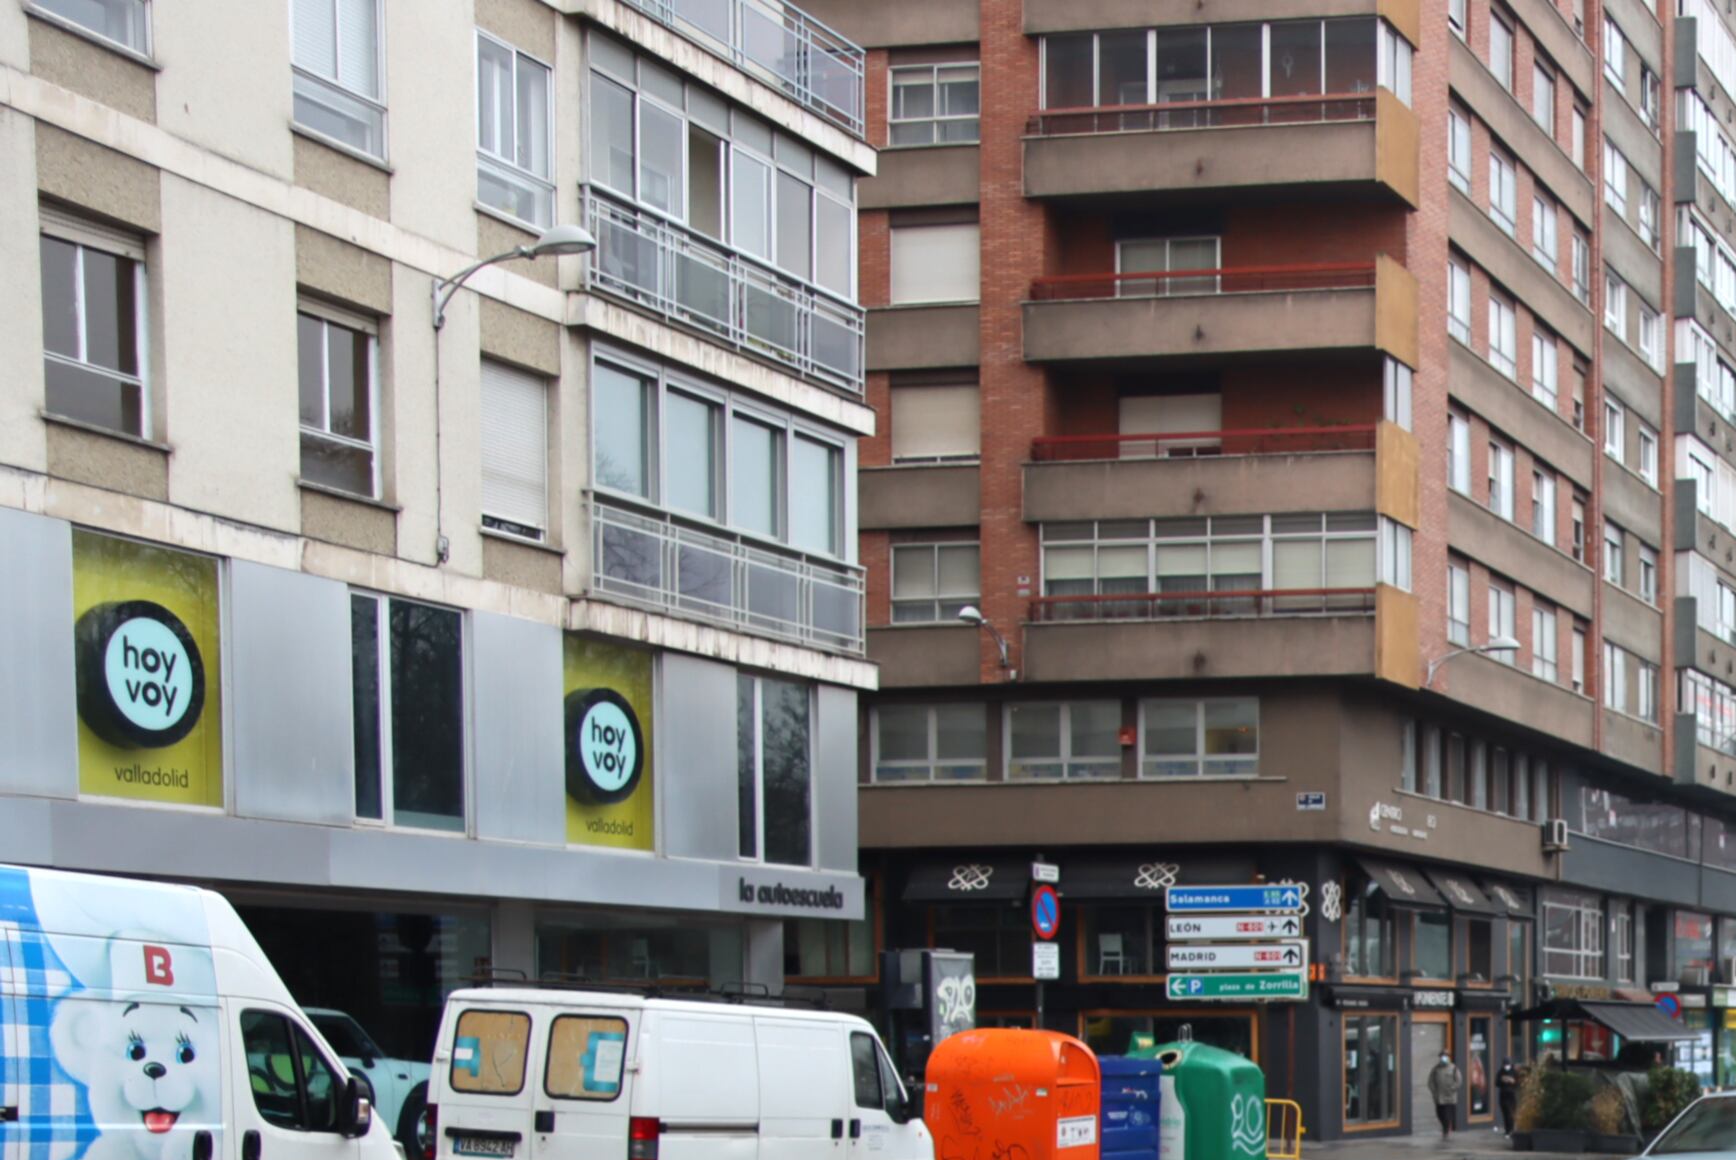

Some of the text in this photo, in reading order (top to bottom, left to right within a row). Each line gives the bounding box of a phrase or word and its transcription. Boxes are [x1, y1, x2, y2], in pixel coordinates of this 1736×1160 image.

[123, 635, 176, 683] hoy
[125, 679, 177, 717] voy
[591, 716, 626, 753] hoy
[114, 764, 189, 788] valladolid
[592, 751, 626, 780] voy
[586, 817, 634, 836] valladolid
[739, 877, 843, 909] la autoescuela
[1169, 893, 1231, 905] Salamanca
[1169, 922, 1202, 933] LEÓN
[143, 945, 174, 987] B
[1170, 952, 1217, 962] MADRID
[1189, 979, 1202, 993] P
[1259, 979, 1299, 991] Zorrilla
